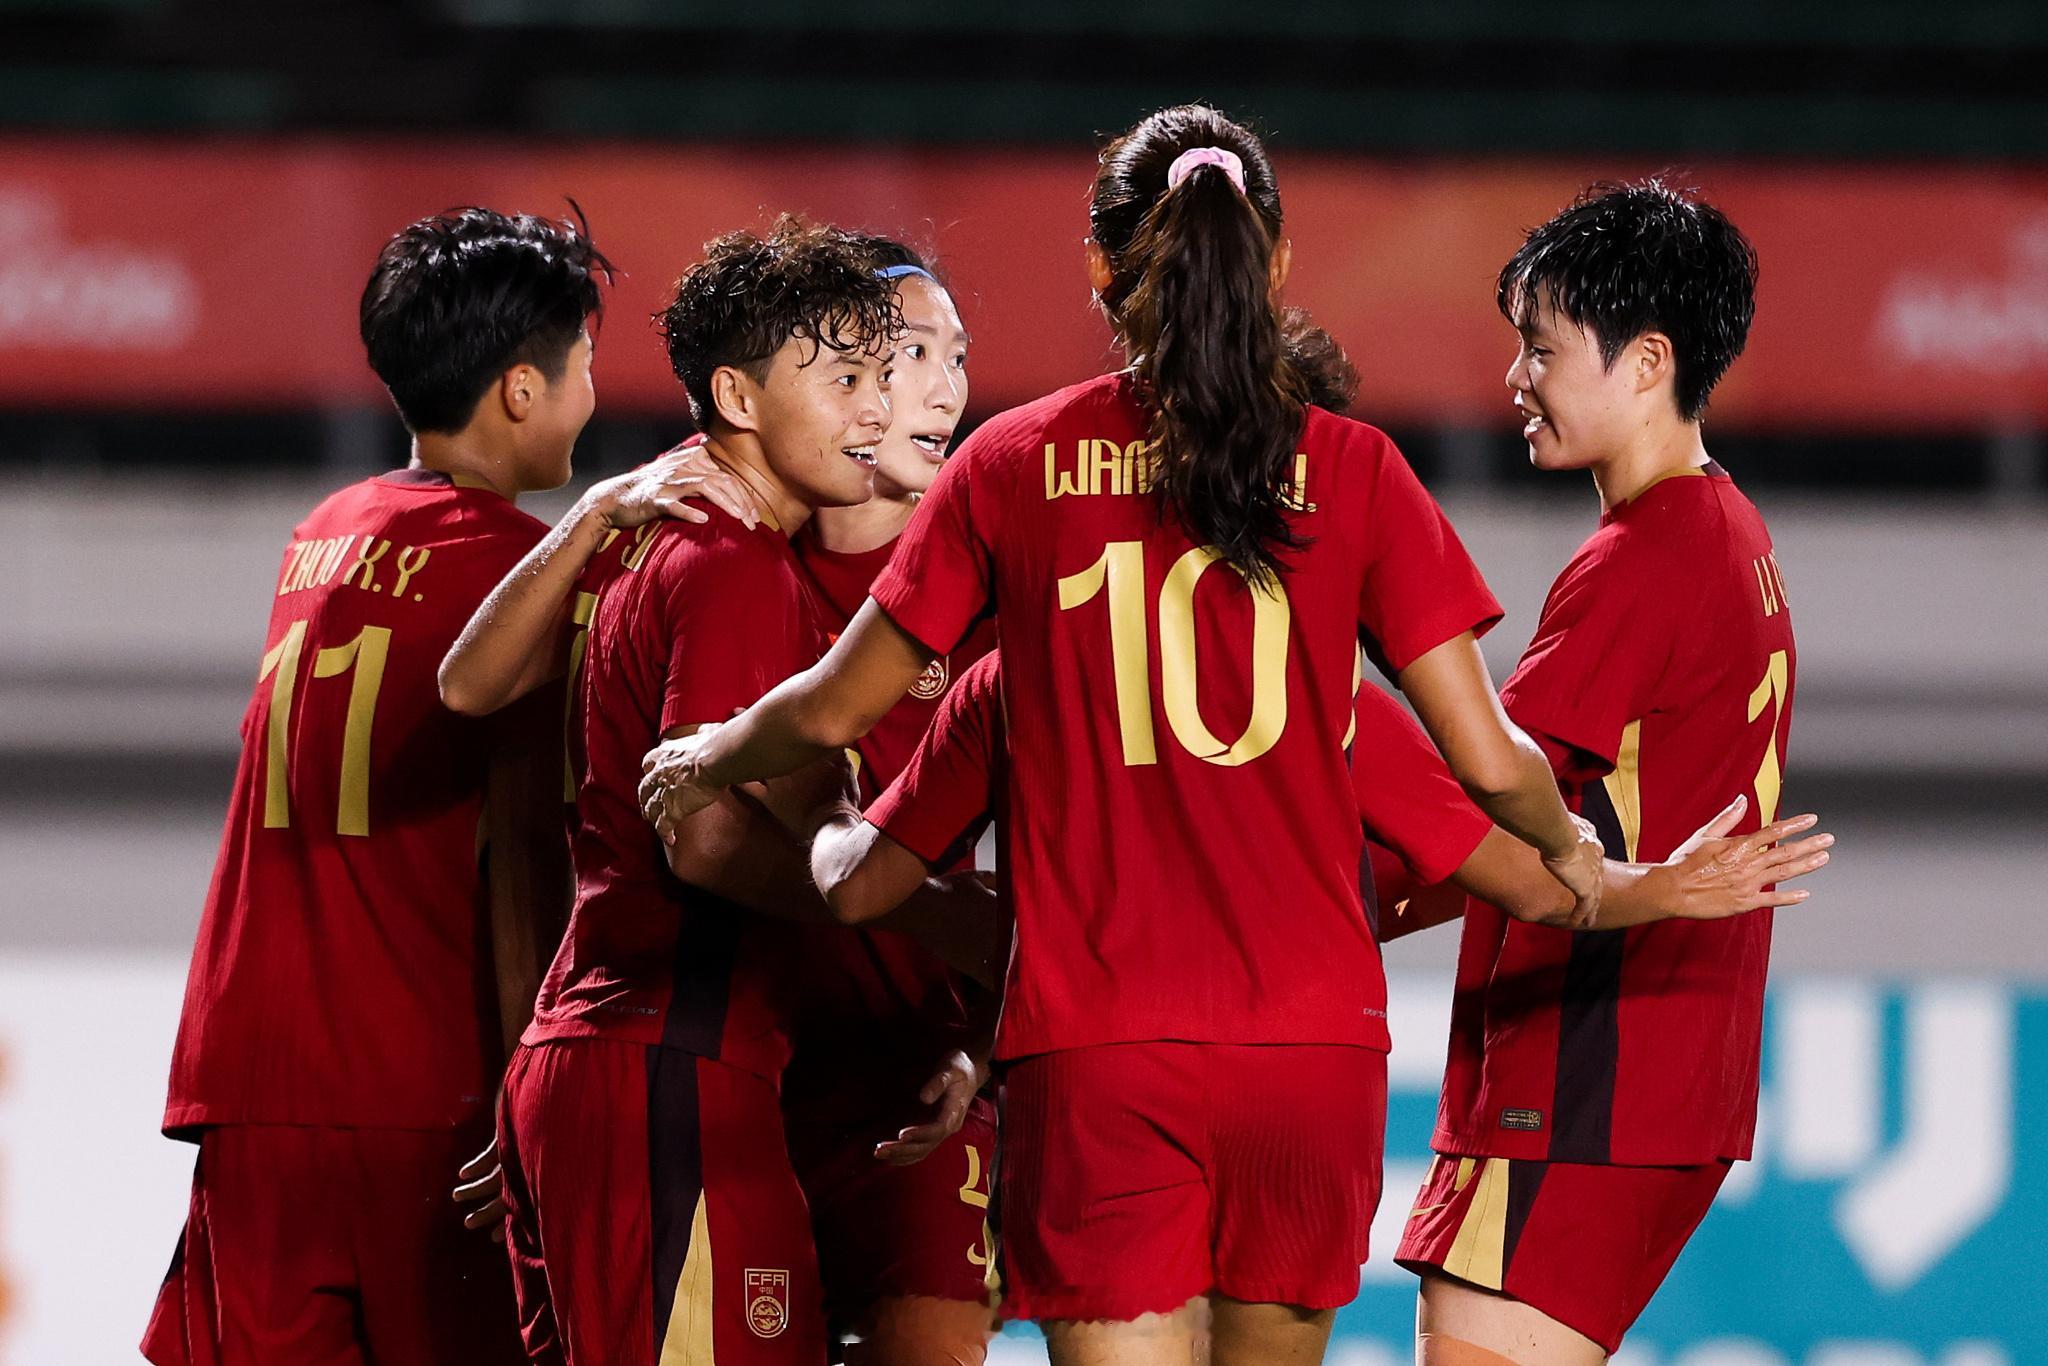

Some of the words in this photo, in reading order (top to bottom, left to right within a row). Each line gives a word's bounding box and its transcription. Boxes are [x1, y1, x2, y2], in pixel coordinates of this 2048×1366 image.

[1044, 438, 1152, 500] WAN
[278, 534, 357, 597] ZHOU
[342, 535, 432, 602] X.Y.
[1057, 540, 1291, 767] 10
[258, 619, 393, 837] 11
[748, 1273, 785, 1287] CFA
